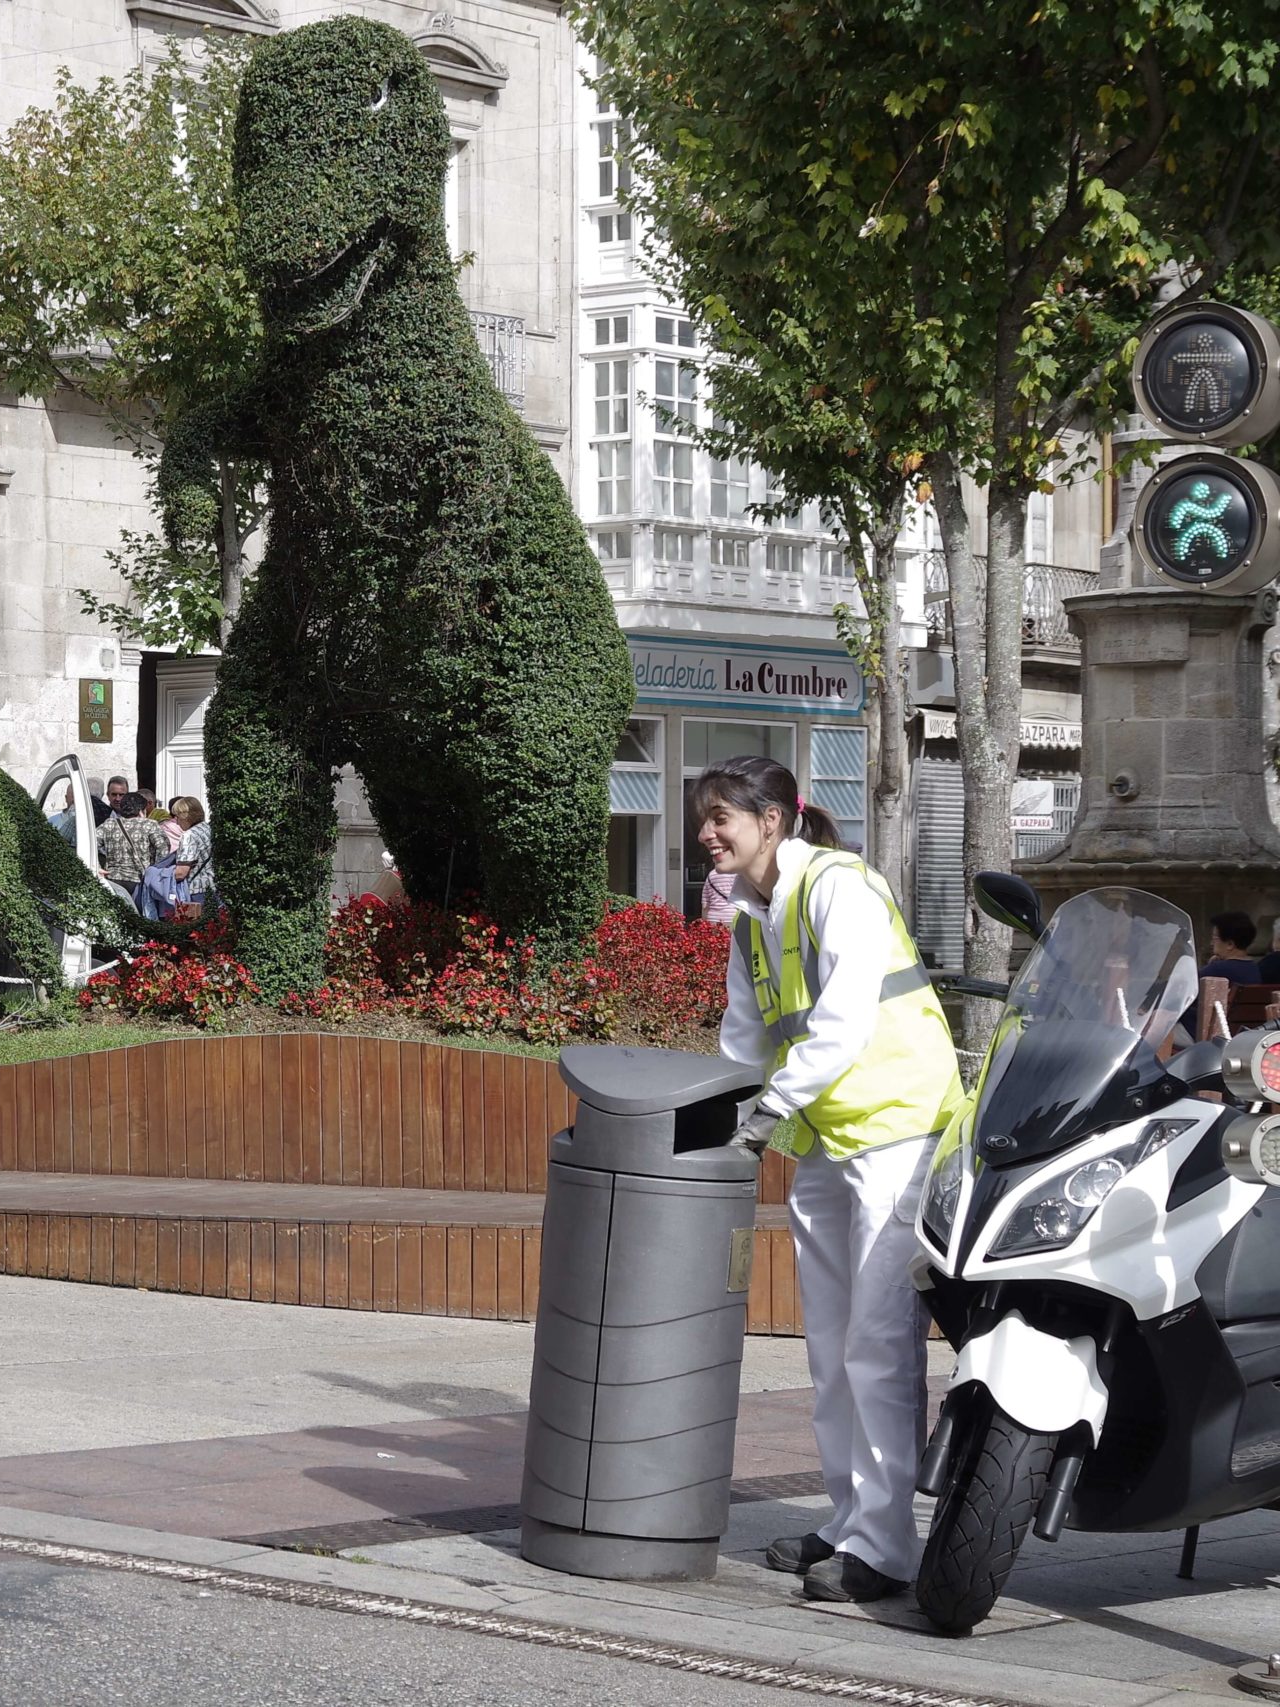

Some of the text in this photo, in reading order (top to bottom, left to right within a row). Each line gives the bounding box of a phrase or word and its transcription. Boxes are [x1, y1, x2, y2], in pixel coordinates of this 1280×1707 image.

[633, 652, 848, 699] eladería La Cumbre
[1019, 725, 1066, 742] GAZPARA
[1020, 818, 1051, 827] GAZPARA
